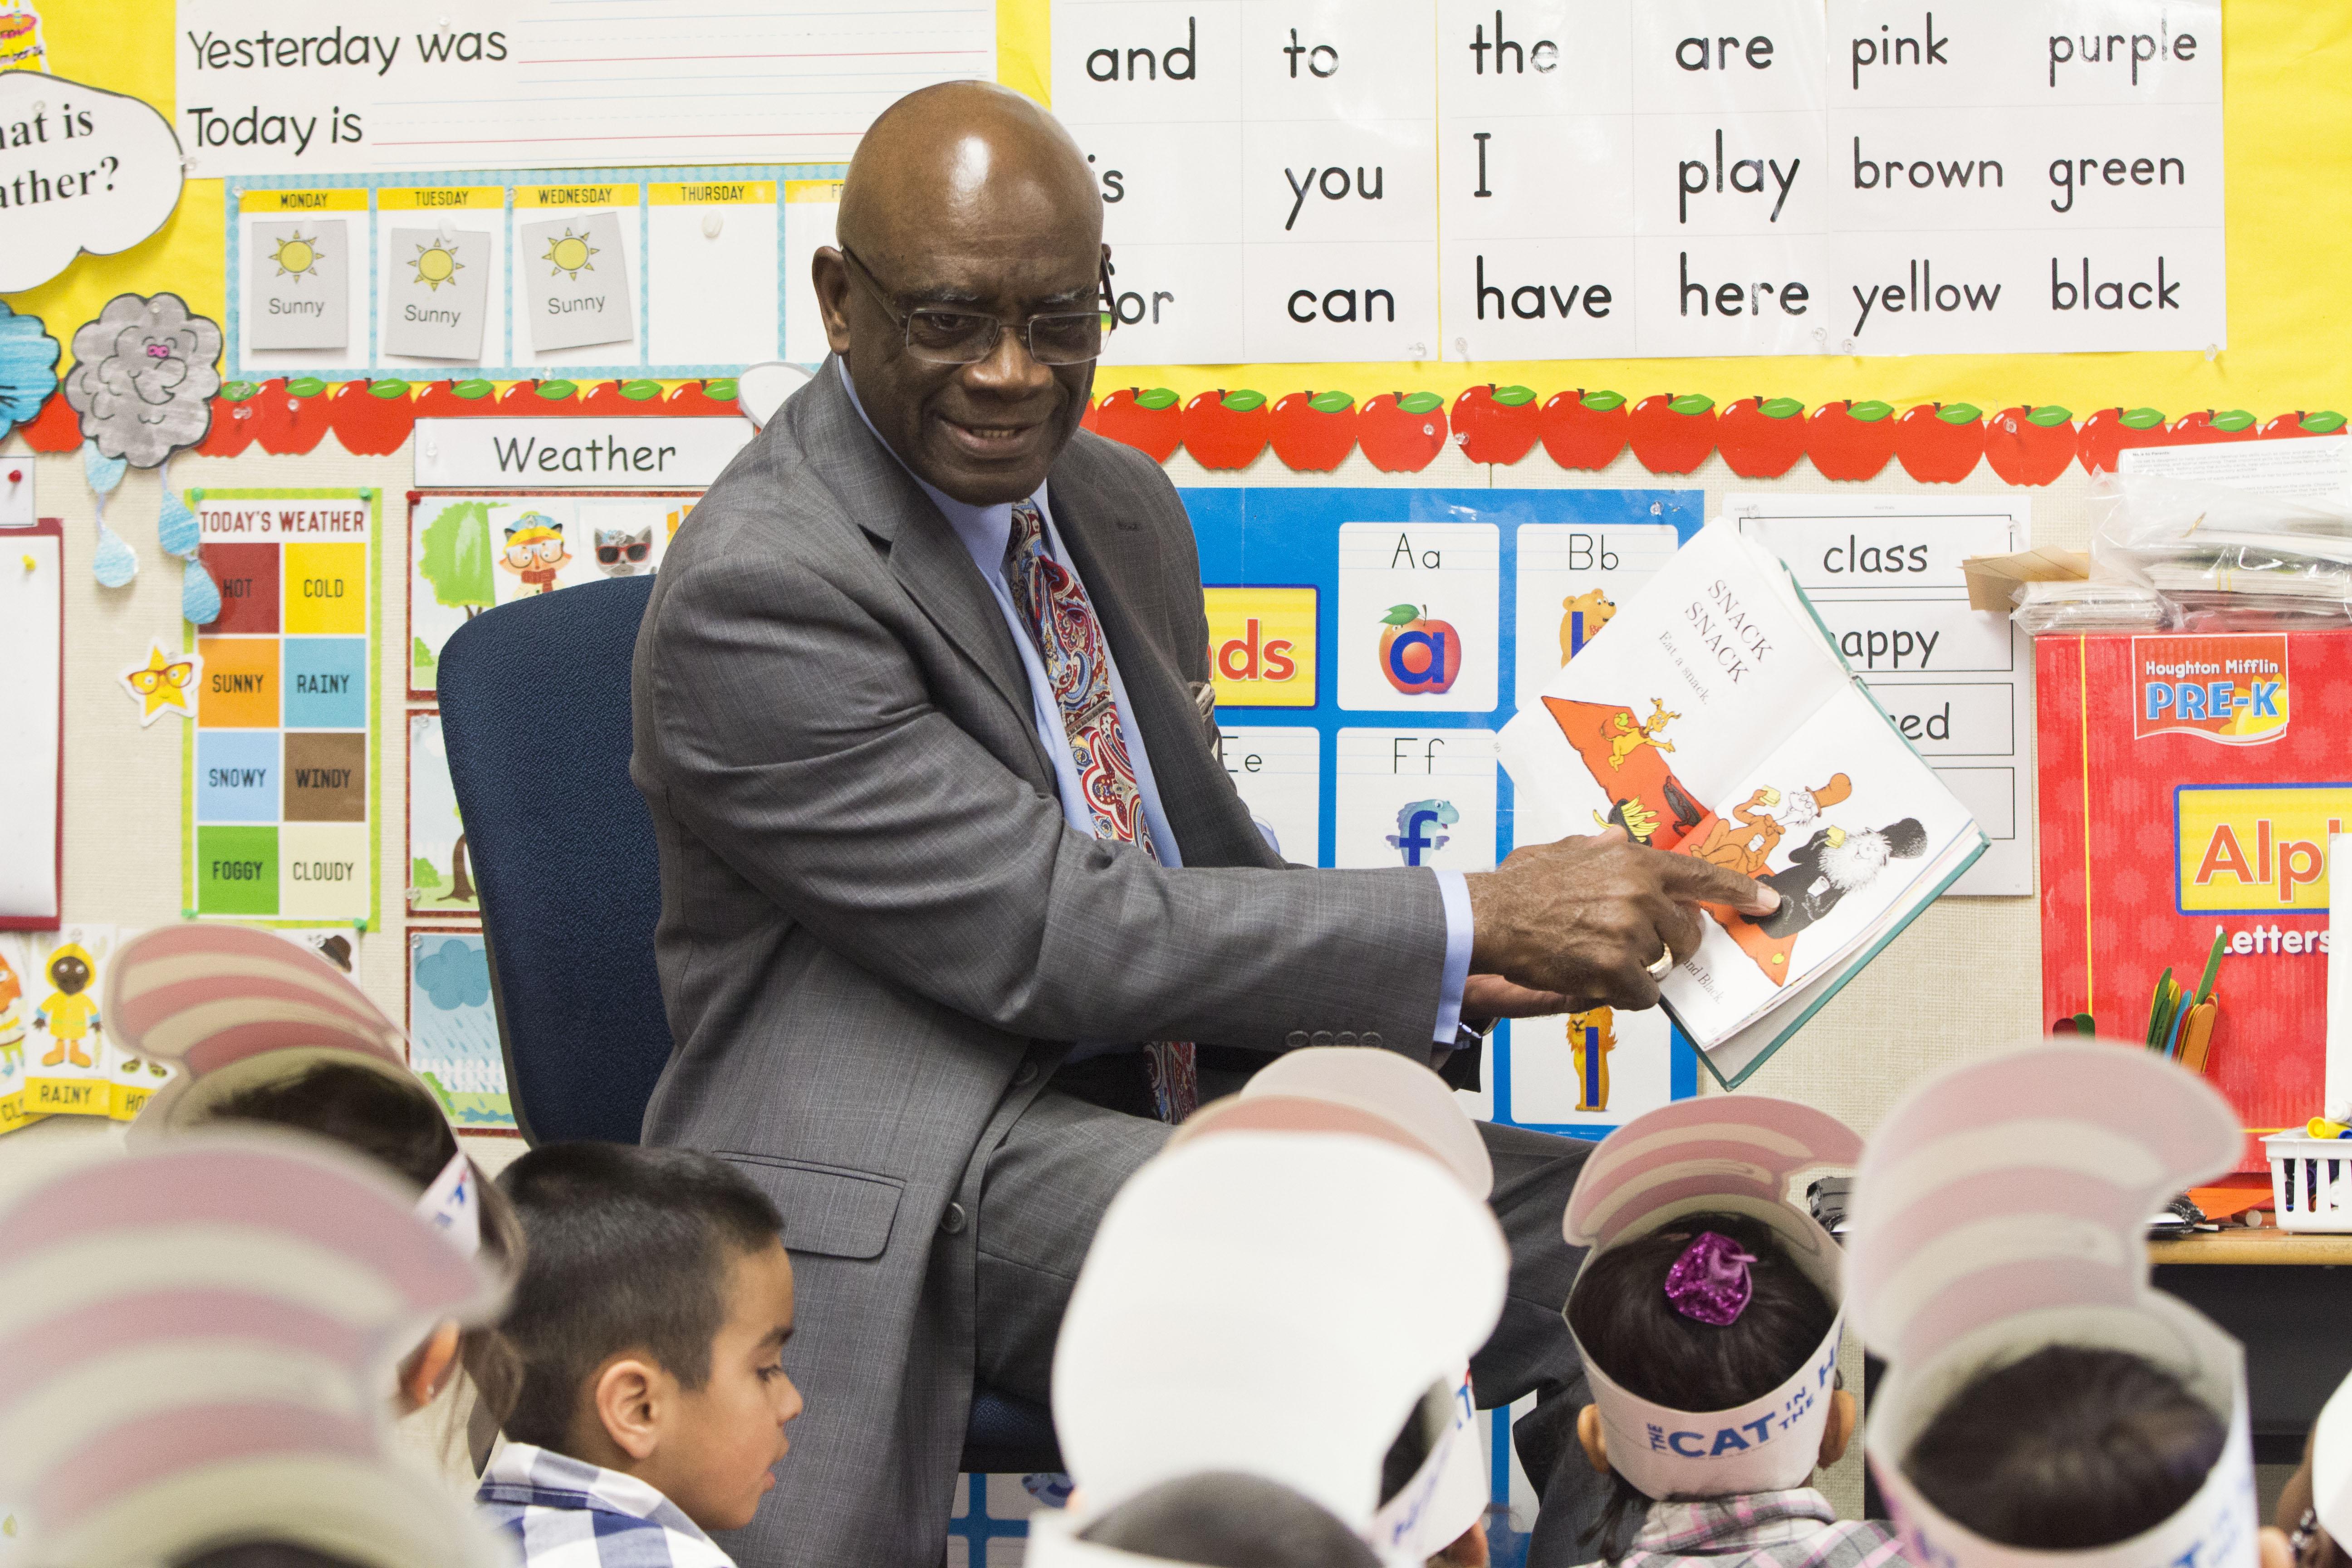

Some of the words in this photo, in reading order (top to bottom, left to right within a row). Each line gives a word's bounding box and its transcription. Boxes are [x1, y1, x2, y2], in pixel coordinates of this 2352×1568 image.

[187, 25, 400, 76] Yesterday
[416, 31, 507, 63] was
[1086, 16, 1196, 82] and
[1283, 28, 1338, 78] to
[1469, 10, 1557, 75] the
[1676, 35, 1774, 71] are
[1852, 11, 1948, 90] pink
[2048, 9, 2197, 88] purple
[64, 103, 93, 138] is
[187, 106, 317, 157] Today
[332, 106, 363, 143] is
[1473, 132, 1492, 198] I
[1679, 128, 1800, 224] play
[1854, 136, 2003, 189] brown
[280, 193, 328, 208] MONDAY
[414, 191, 469, 206] TUESDAY
[538, 188, 612, 204] WEDNESDAY
[681, 185, 745, 201] THURSDAY
[1284, 166, 1383, 231] you
[2049, 157, 2184, 213] green
[1476, 255, 1612, 320] have
[1680, 251, 1809, 316] here
[1852, 259, 2001, 337] yellow
[2052, 256, 2180, 310] black
[269, 297, 325, 318] Sunny
[404, 304, 461, 328] Sunny
[548, 296, 605, 315] Sunny
[1288, 289, 1394, 323] can
[493, 434, 676, 473] Weather
[201, 511, 272, 533] TODAY'S
[279, 510, 364, 532] WEATHER
[1391, 532, 1441, 569] Aa
[1569, 533, 1619, 571] Bb
[1823, 534, 1928, 573] class
[223, 578, 253, 598] HOT
[304, 578, 344, 598] COLD
[1708, 580, 1773, 662] SNACK
[1207, 617, 1296, 681] ds
[1685, 602, 1749, 685] SNACK
[1829, 630, 1940, 669] appy
[212, 674, 264, 693] SUNNY
[297, 674, 349, 694] RAINY
[1660, 630, 1677, 656] Eat
[1675, 657, 1683, 666] a
[1682, 667, 1709, 705] snack.
[2146, 661, 2220, 679] Houghton
[2225, 659, 2278, 674] Mifflin
[2146, 681, 2281, 720] PRE-K
[1888, 701, 1950, 740] ed
[209, 768, 266, 788] SNOWY
[295, 768, 351, 789] WINDY
[212, 860, 264, 881] FOGGY
[293, 861, 354, 882] CLOUDY
[2193, 818, 2342, 903] Alp
[1697, 974, 1724, 1004] Black.
[40, 1085, 92, 1105] RAINY
[1779, 1394, 1815, 1431] THE
[1785, 1386, 1808, 1412] IN
[1647, 1422, 1666, 1451] THE
[1668, 1411, 1777, 1458] CAT
